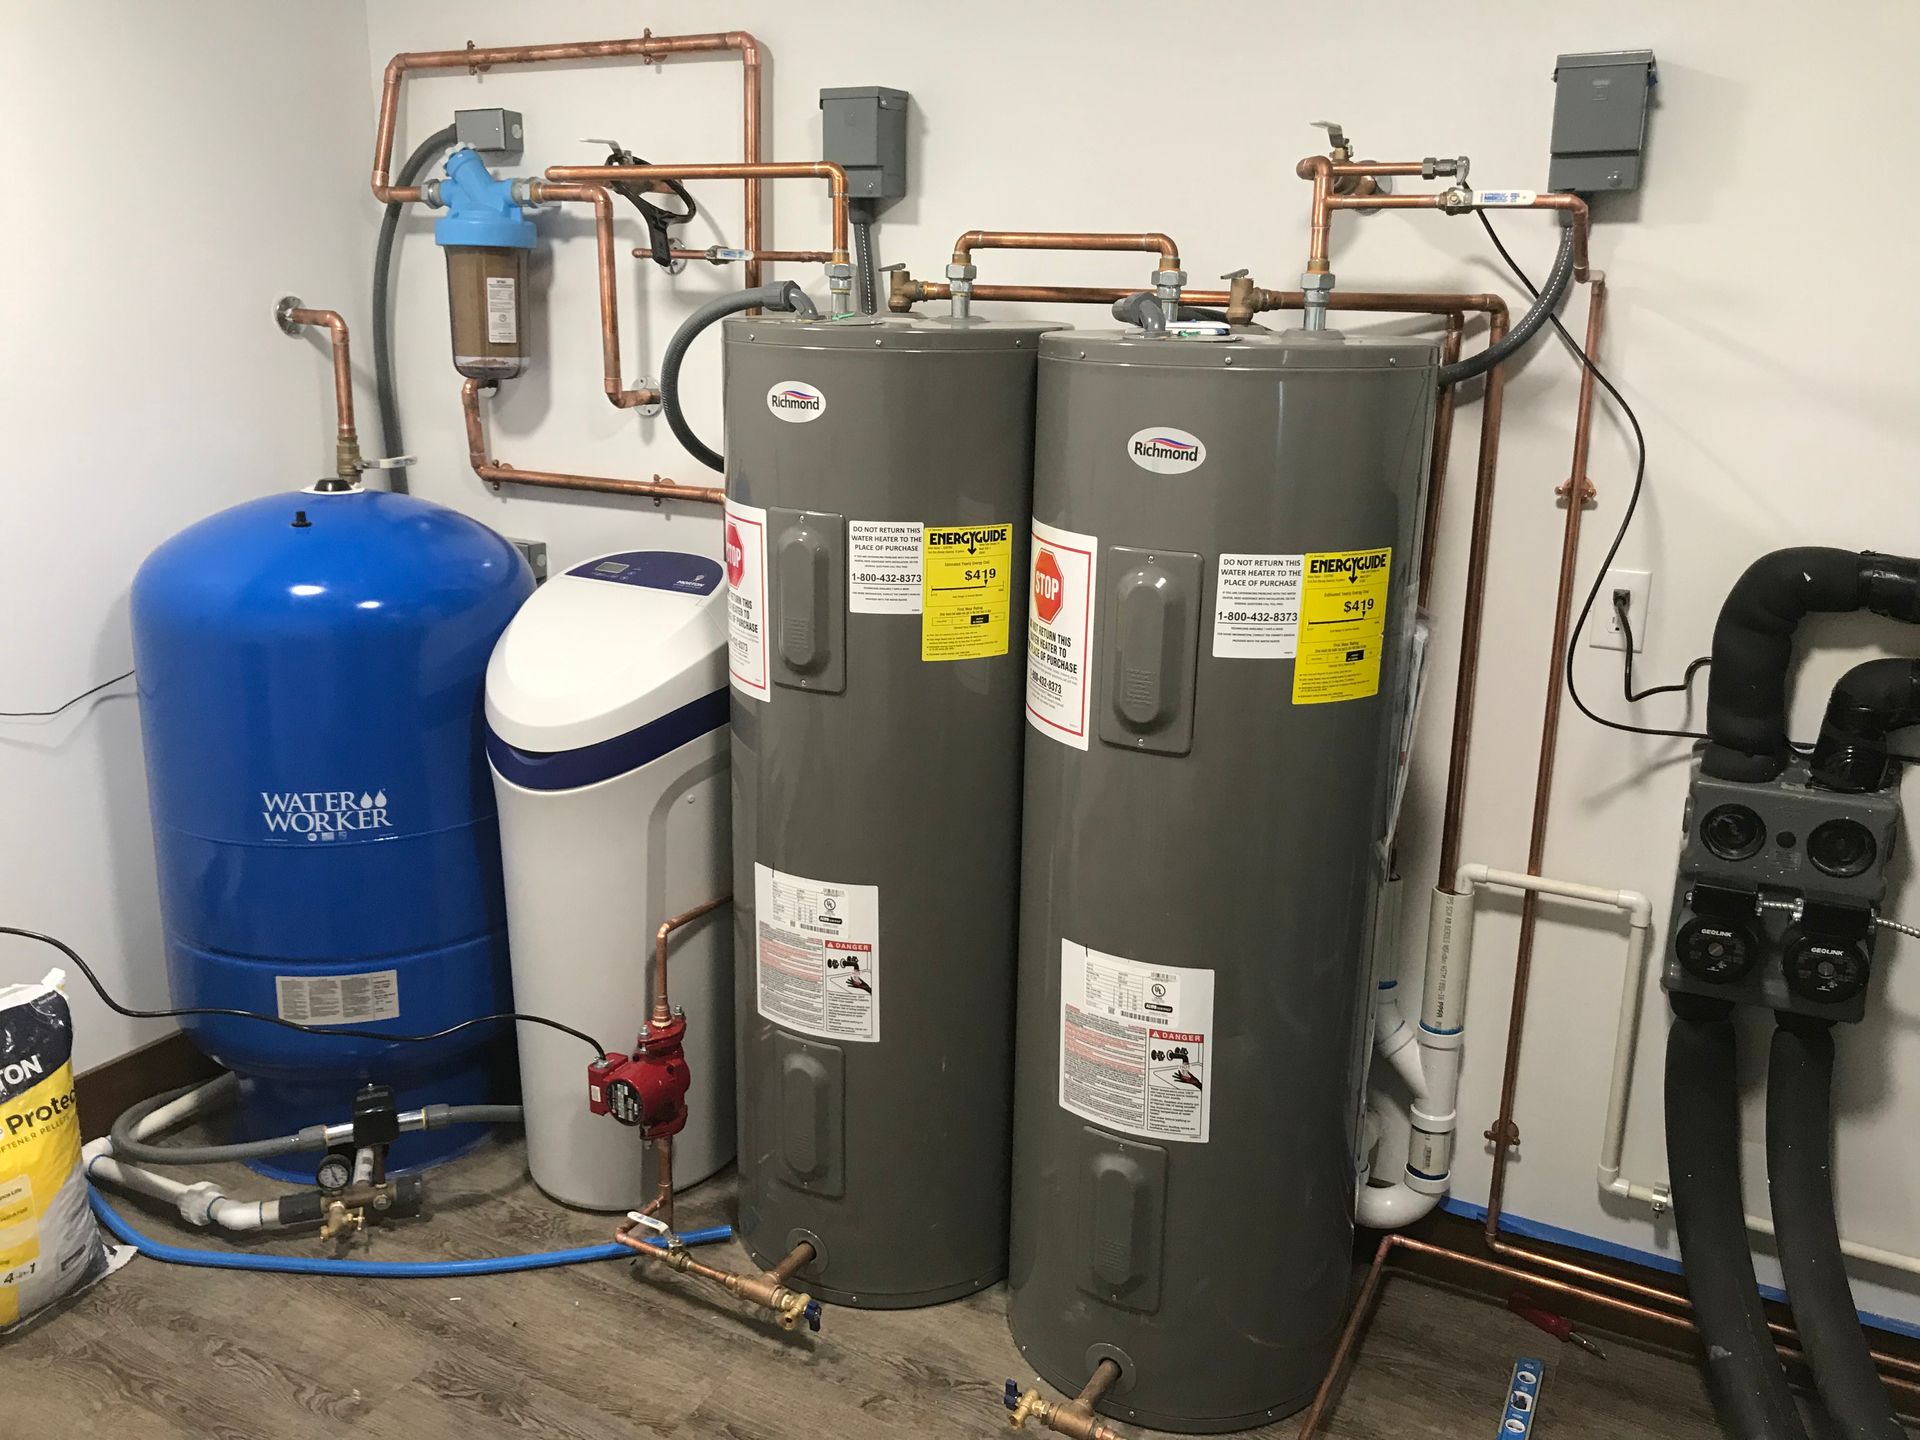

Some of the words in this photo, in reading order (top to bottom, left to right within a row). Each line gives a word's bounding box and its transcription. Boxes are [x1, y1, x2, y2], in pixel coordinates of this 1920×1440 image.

[772, 394, 819, 410] Richmond
[1134, 441, 1198, 462] Richmond
[879, 526, 906, 534] RETURN
[874, 535, 899, 543] HEATER
[929, 529, 1007, 547] ENERGYGUIDE
[1310, 553, 1387, 575] ENERGYGUIDE
[851, 573, 922, 582] 1-800-432-8373
[964, 568, 997, 581] $419
[1035, 570, 1060, 601] STOP
[1343, 598, 1374, 613] $419
[1218, 612, 1298, 622] 1-800-432-8373
[1038, 625, 1056, 642] RETURN
[1057, 634, 1072, 647] THIS
[1040, 637, 1057, 655] HEATER
[1058, 646, 1067, 658] TO
[1046, 653, 1078, 674] PURCHASE
[260, 791, 361, 812] WATER
[263, 808, 394, 832] WORKER
[1701, 928, 1733, 938] GEOLINK
[835, 942, 869, 951] DANGER
[1811, 947, 1845, 957] GEOLINK
[1162, 1032, 1201, 1042] DANGER
